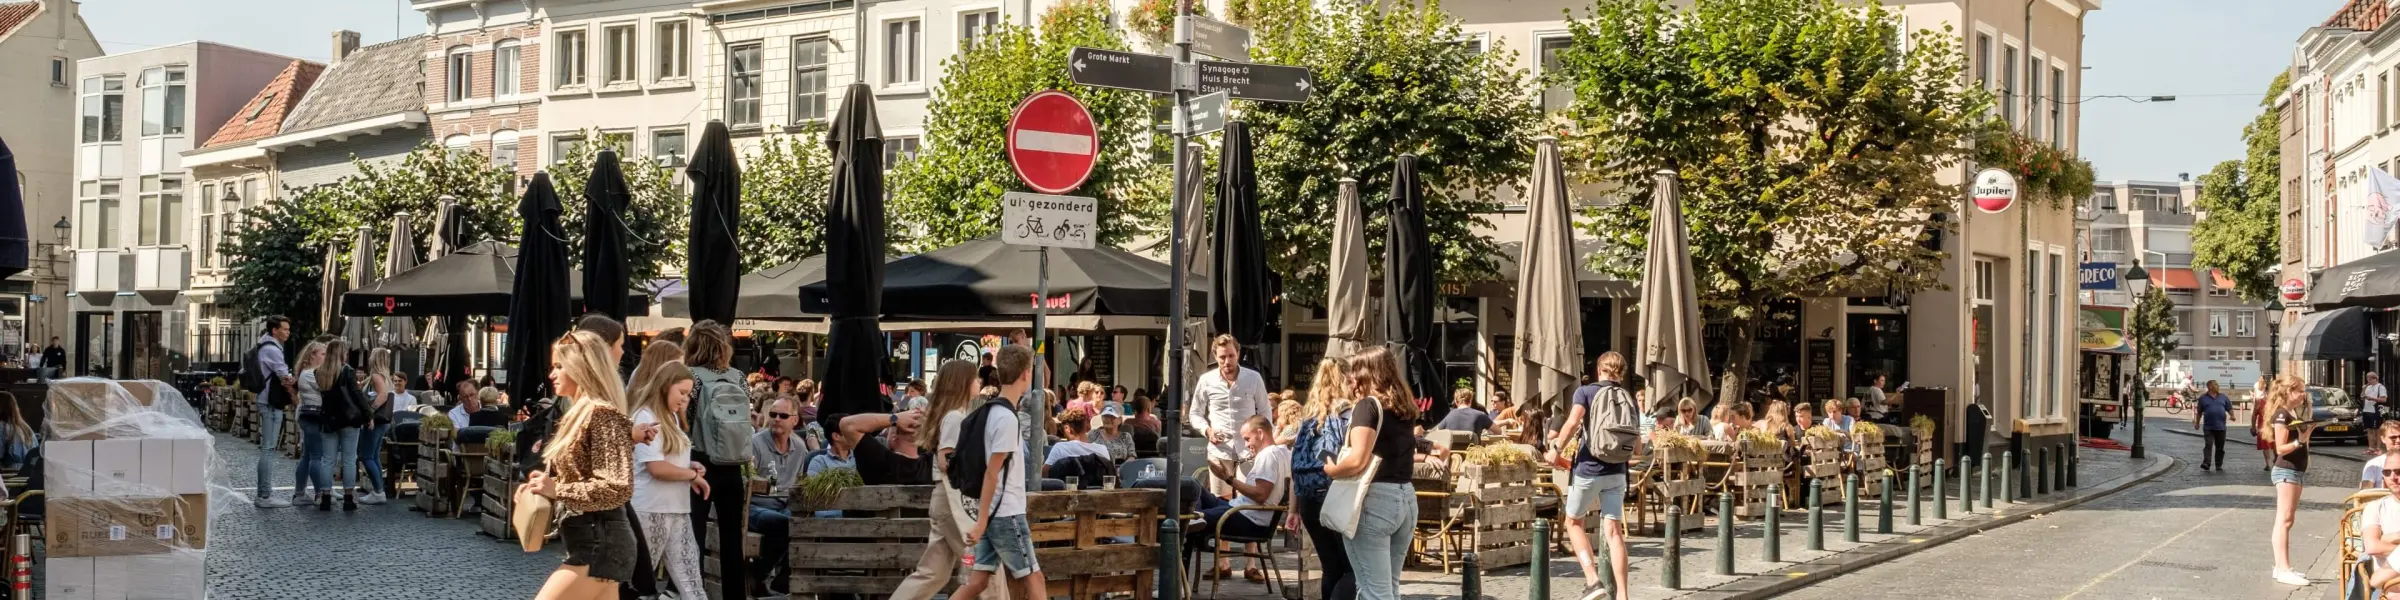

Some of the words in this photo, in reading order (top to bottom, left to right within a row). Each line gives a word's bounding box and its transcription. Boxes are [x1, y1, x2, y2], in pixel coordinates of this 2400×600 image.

[1087, 51, 1107, 62] Grote
[1109, 53, 1130, 64] Markt
[1202, 64, 1241, 75] Synagoge
[1202, 75, 1221, 83] Huis
[1223, 76, 1250, 85] Brecht
[1974, 186, 2012, 196] Jupiler
[1010, 197, 1093, 212] uigezonderd
